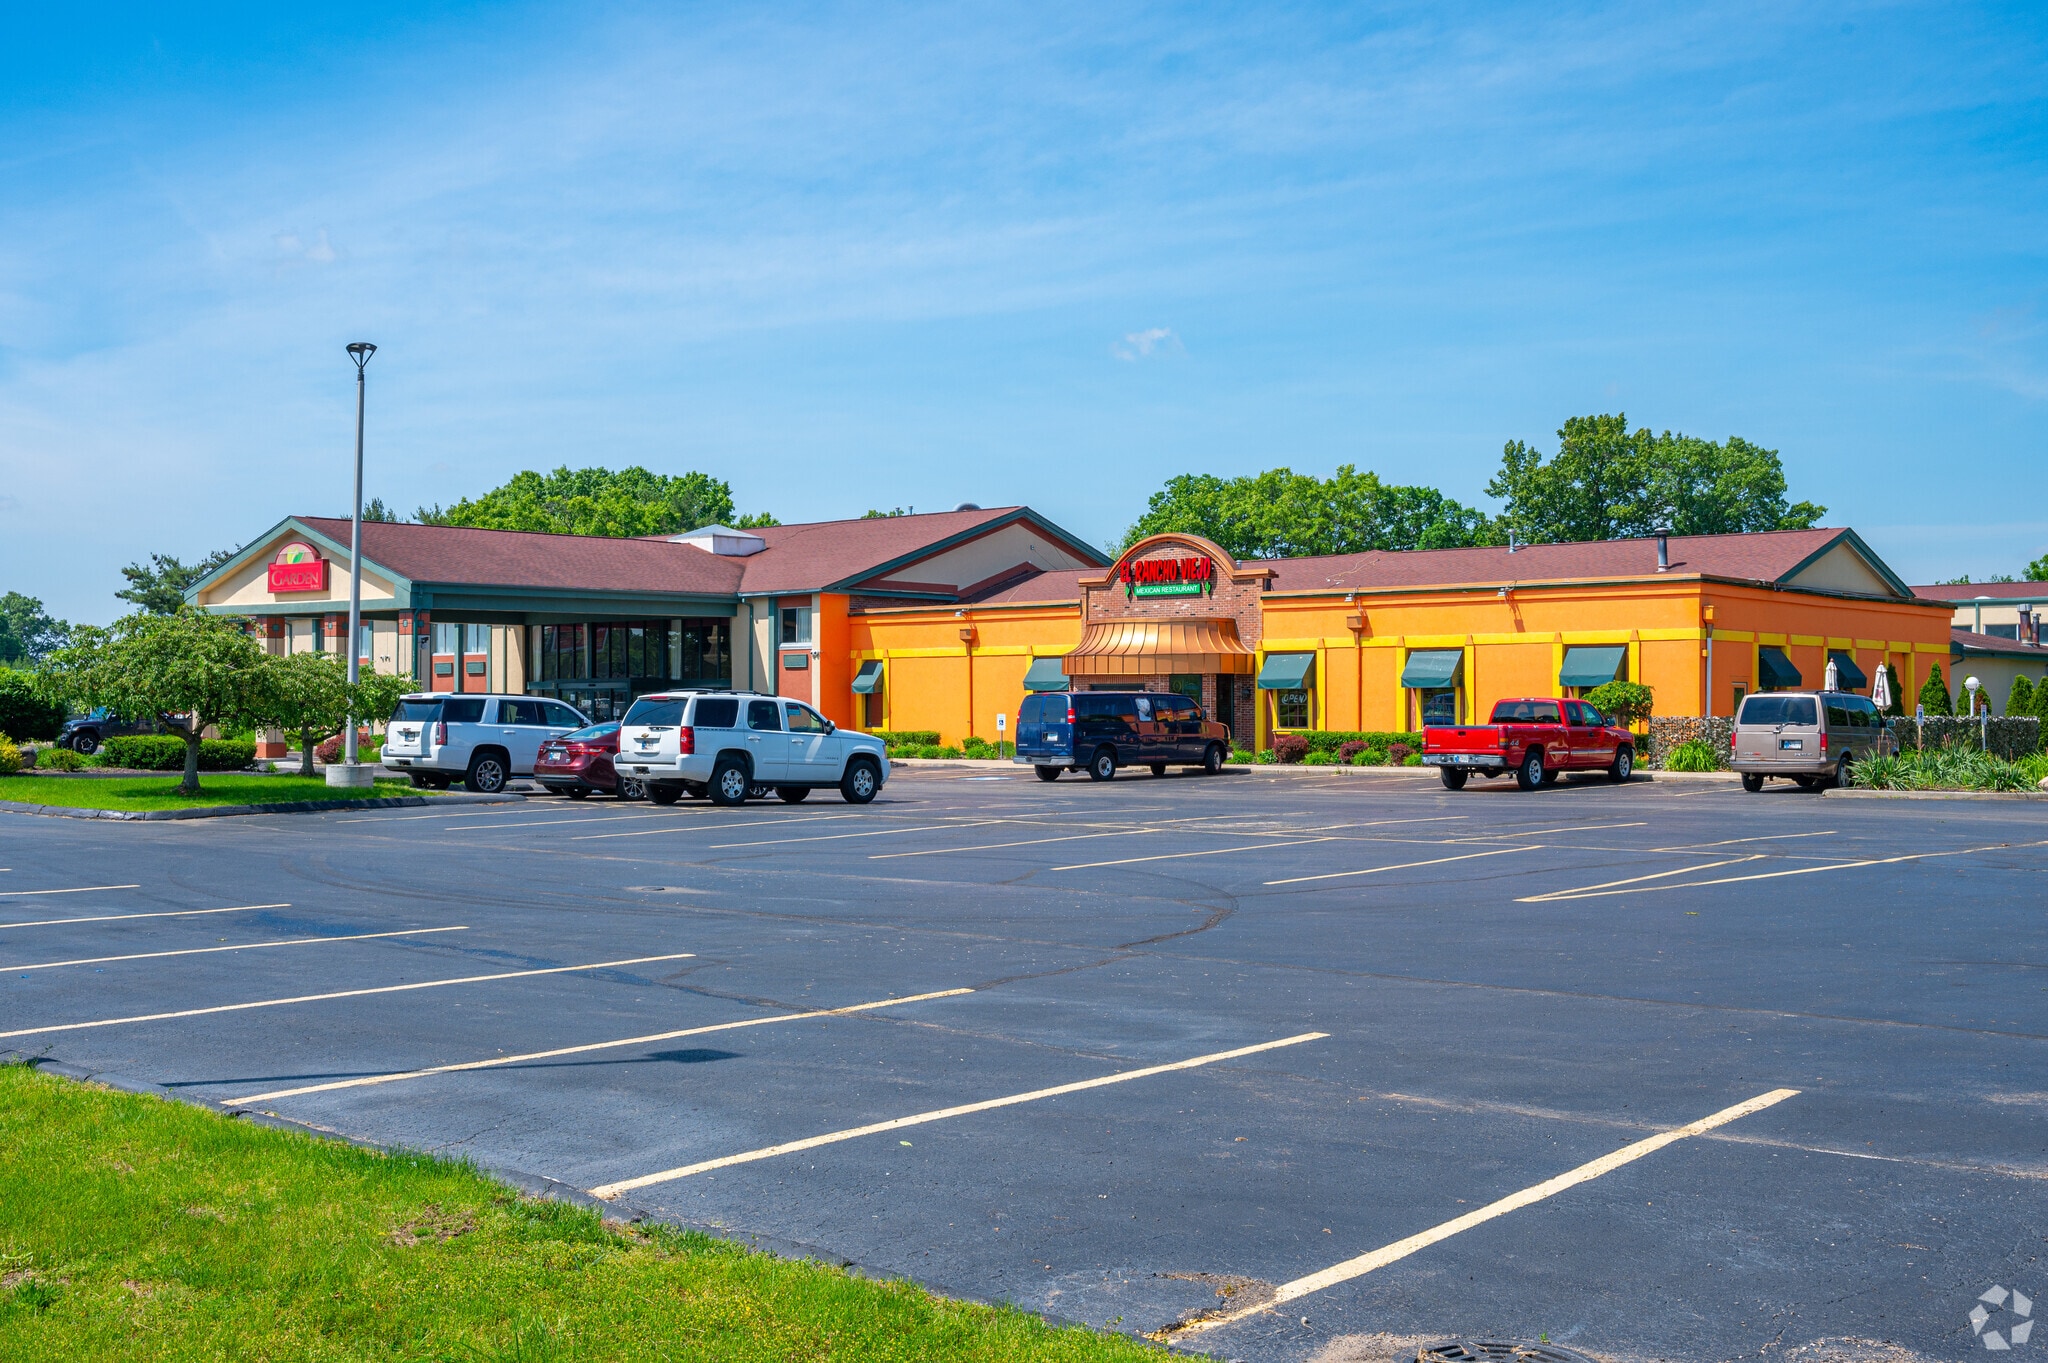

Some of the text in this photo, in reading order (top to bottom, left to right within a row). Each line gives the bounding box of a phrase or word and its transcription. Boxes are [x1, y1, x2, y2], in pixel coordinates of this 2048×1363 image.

[1120, 557, 1211, 582] EL RANCHO VIEJO
[271, 570, 318, 586] GARDEN
[1161, 585, 1198, 593] RESTAURANT
[1284, 693, 1305, 703] OPEN
